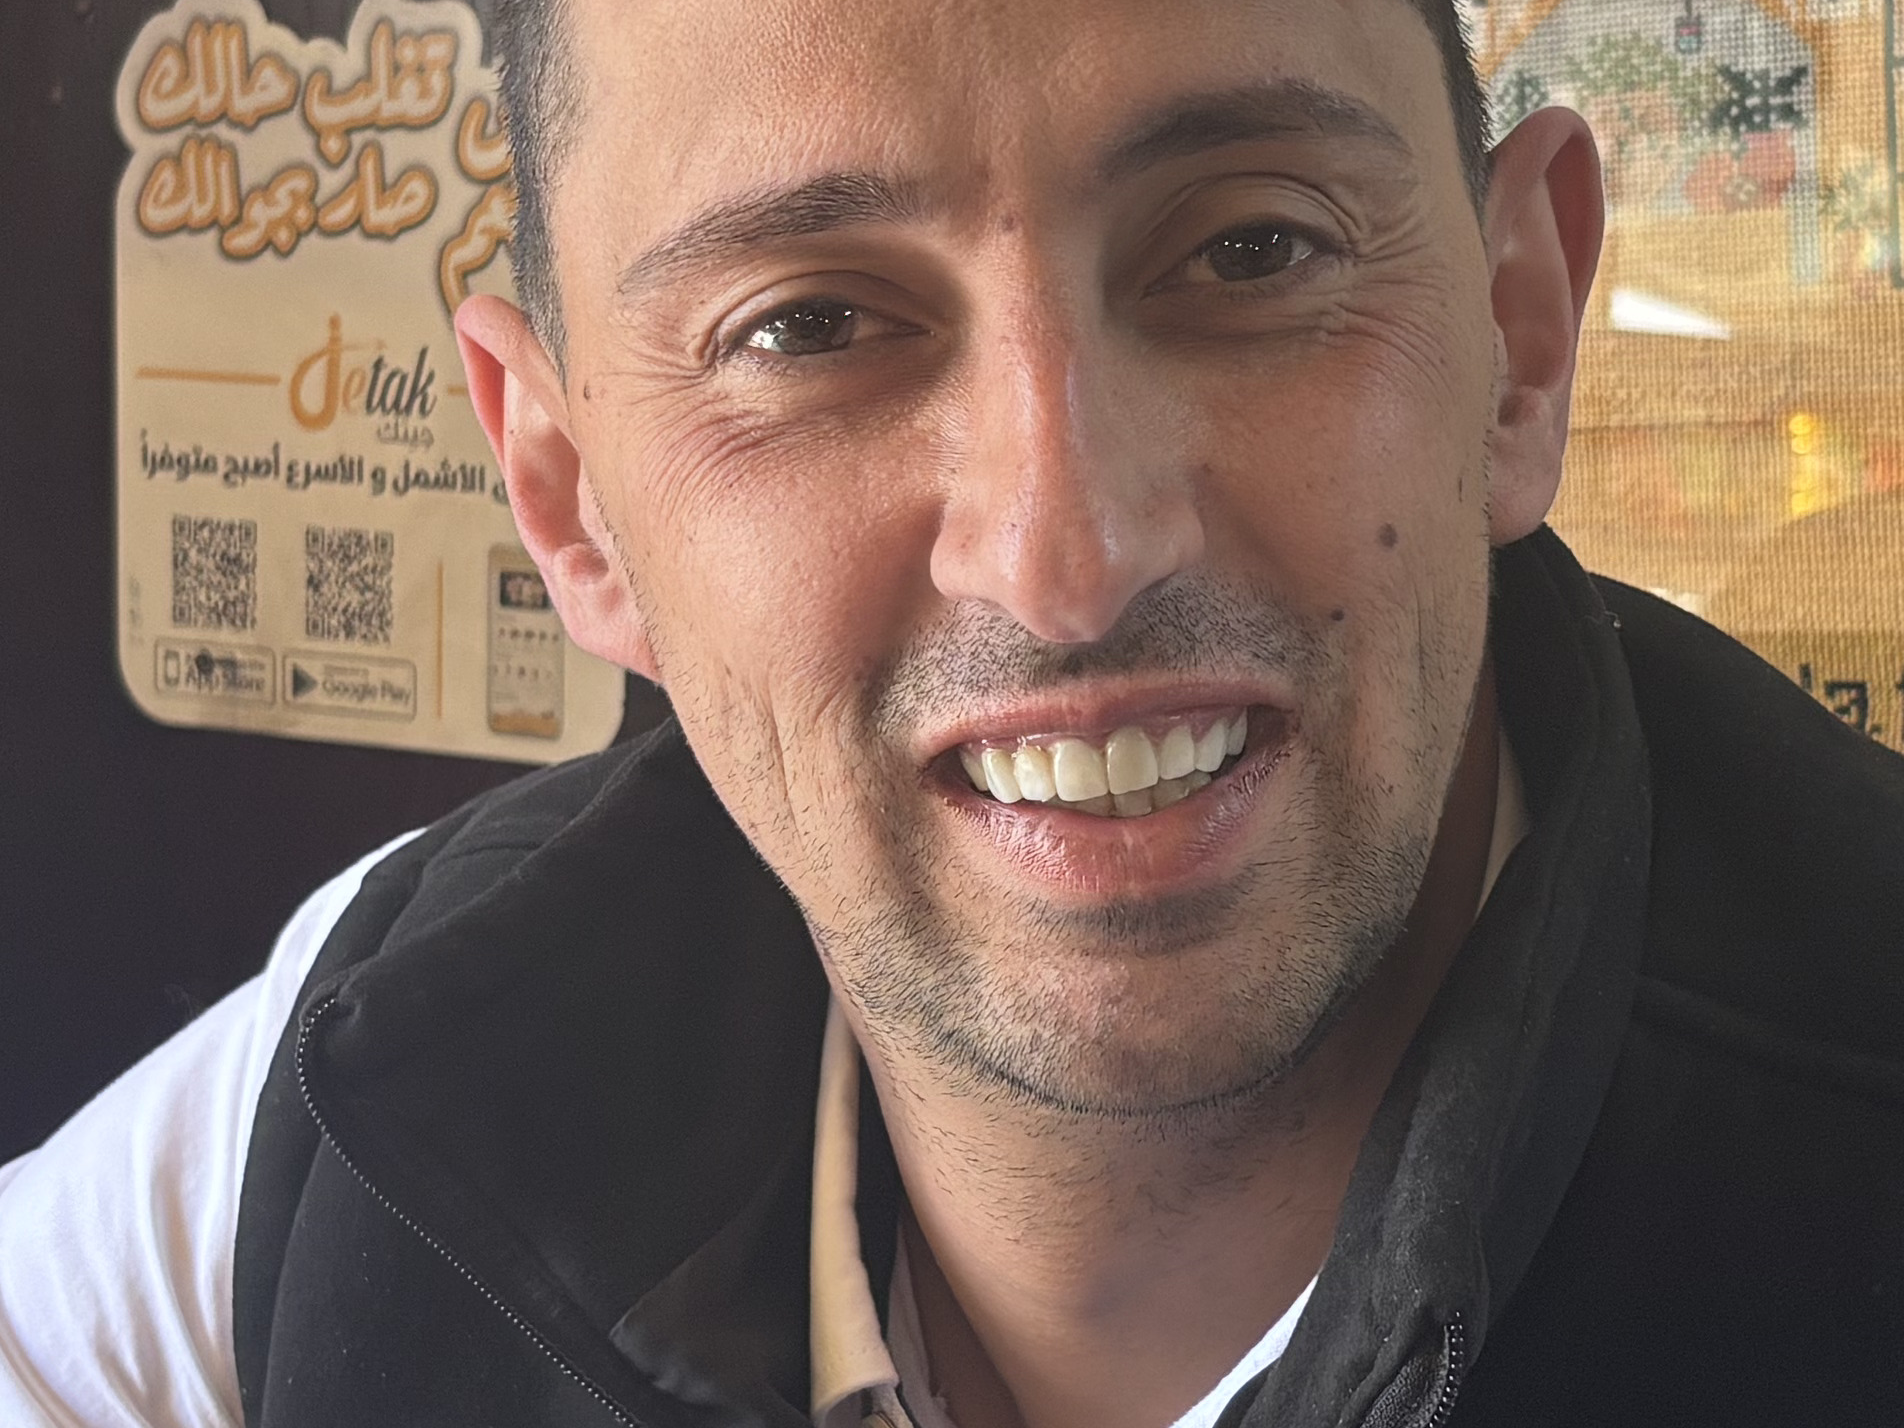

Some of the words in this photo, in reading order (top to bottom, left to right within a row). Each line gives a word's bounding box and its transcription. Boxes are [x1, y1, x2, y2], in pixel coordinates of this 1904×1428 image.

[137, 15, 297, 132] حالك
[287, 312, 438, 432] Jetak
[371, 463, 387, 497] و
[321, 678, 377, 704] Google
[381, 681, 412, 707] Play
